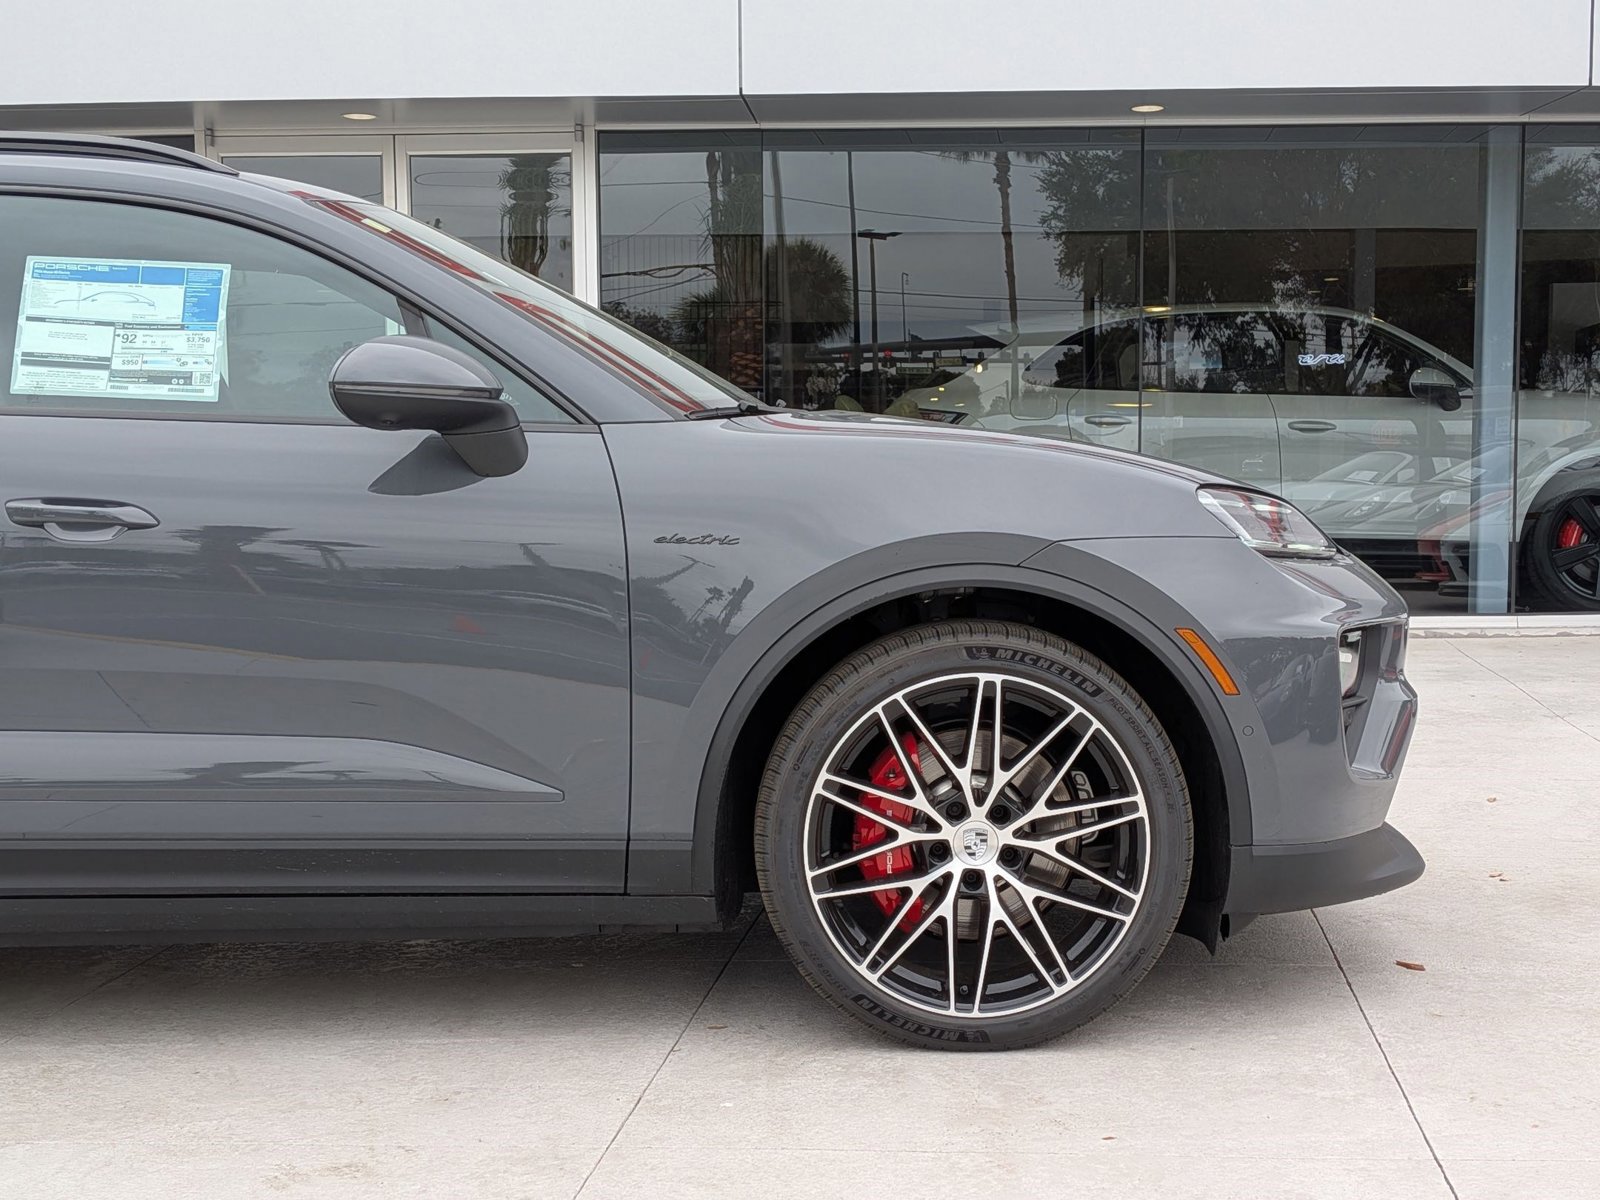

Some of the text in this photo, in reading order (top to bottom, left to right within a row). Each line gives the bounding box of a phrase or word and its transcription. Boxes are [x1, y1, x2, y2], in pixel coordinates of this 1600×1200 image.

[34, 262, 110, 272] PORSCHE
[121, 334, 137, 343] 92
[654, 533, 740, 545] electric
[995, 649, 1098, 694] MICHELIN
[1108, 697, 1127, 718] PILOT
[1126, 716, 1146, 741] SPORT
[1143, 740, 1155, 756] ALL
[1152, 756, 1168, 789] SEASON
[857, 1000, 960, 1041] MICHELIN
